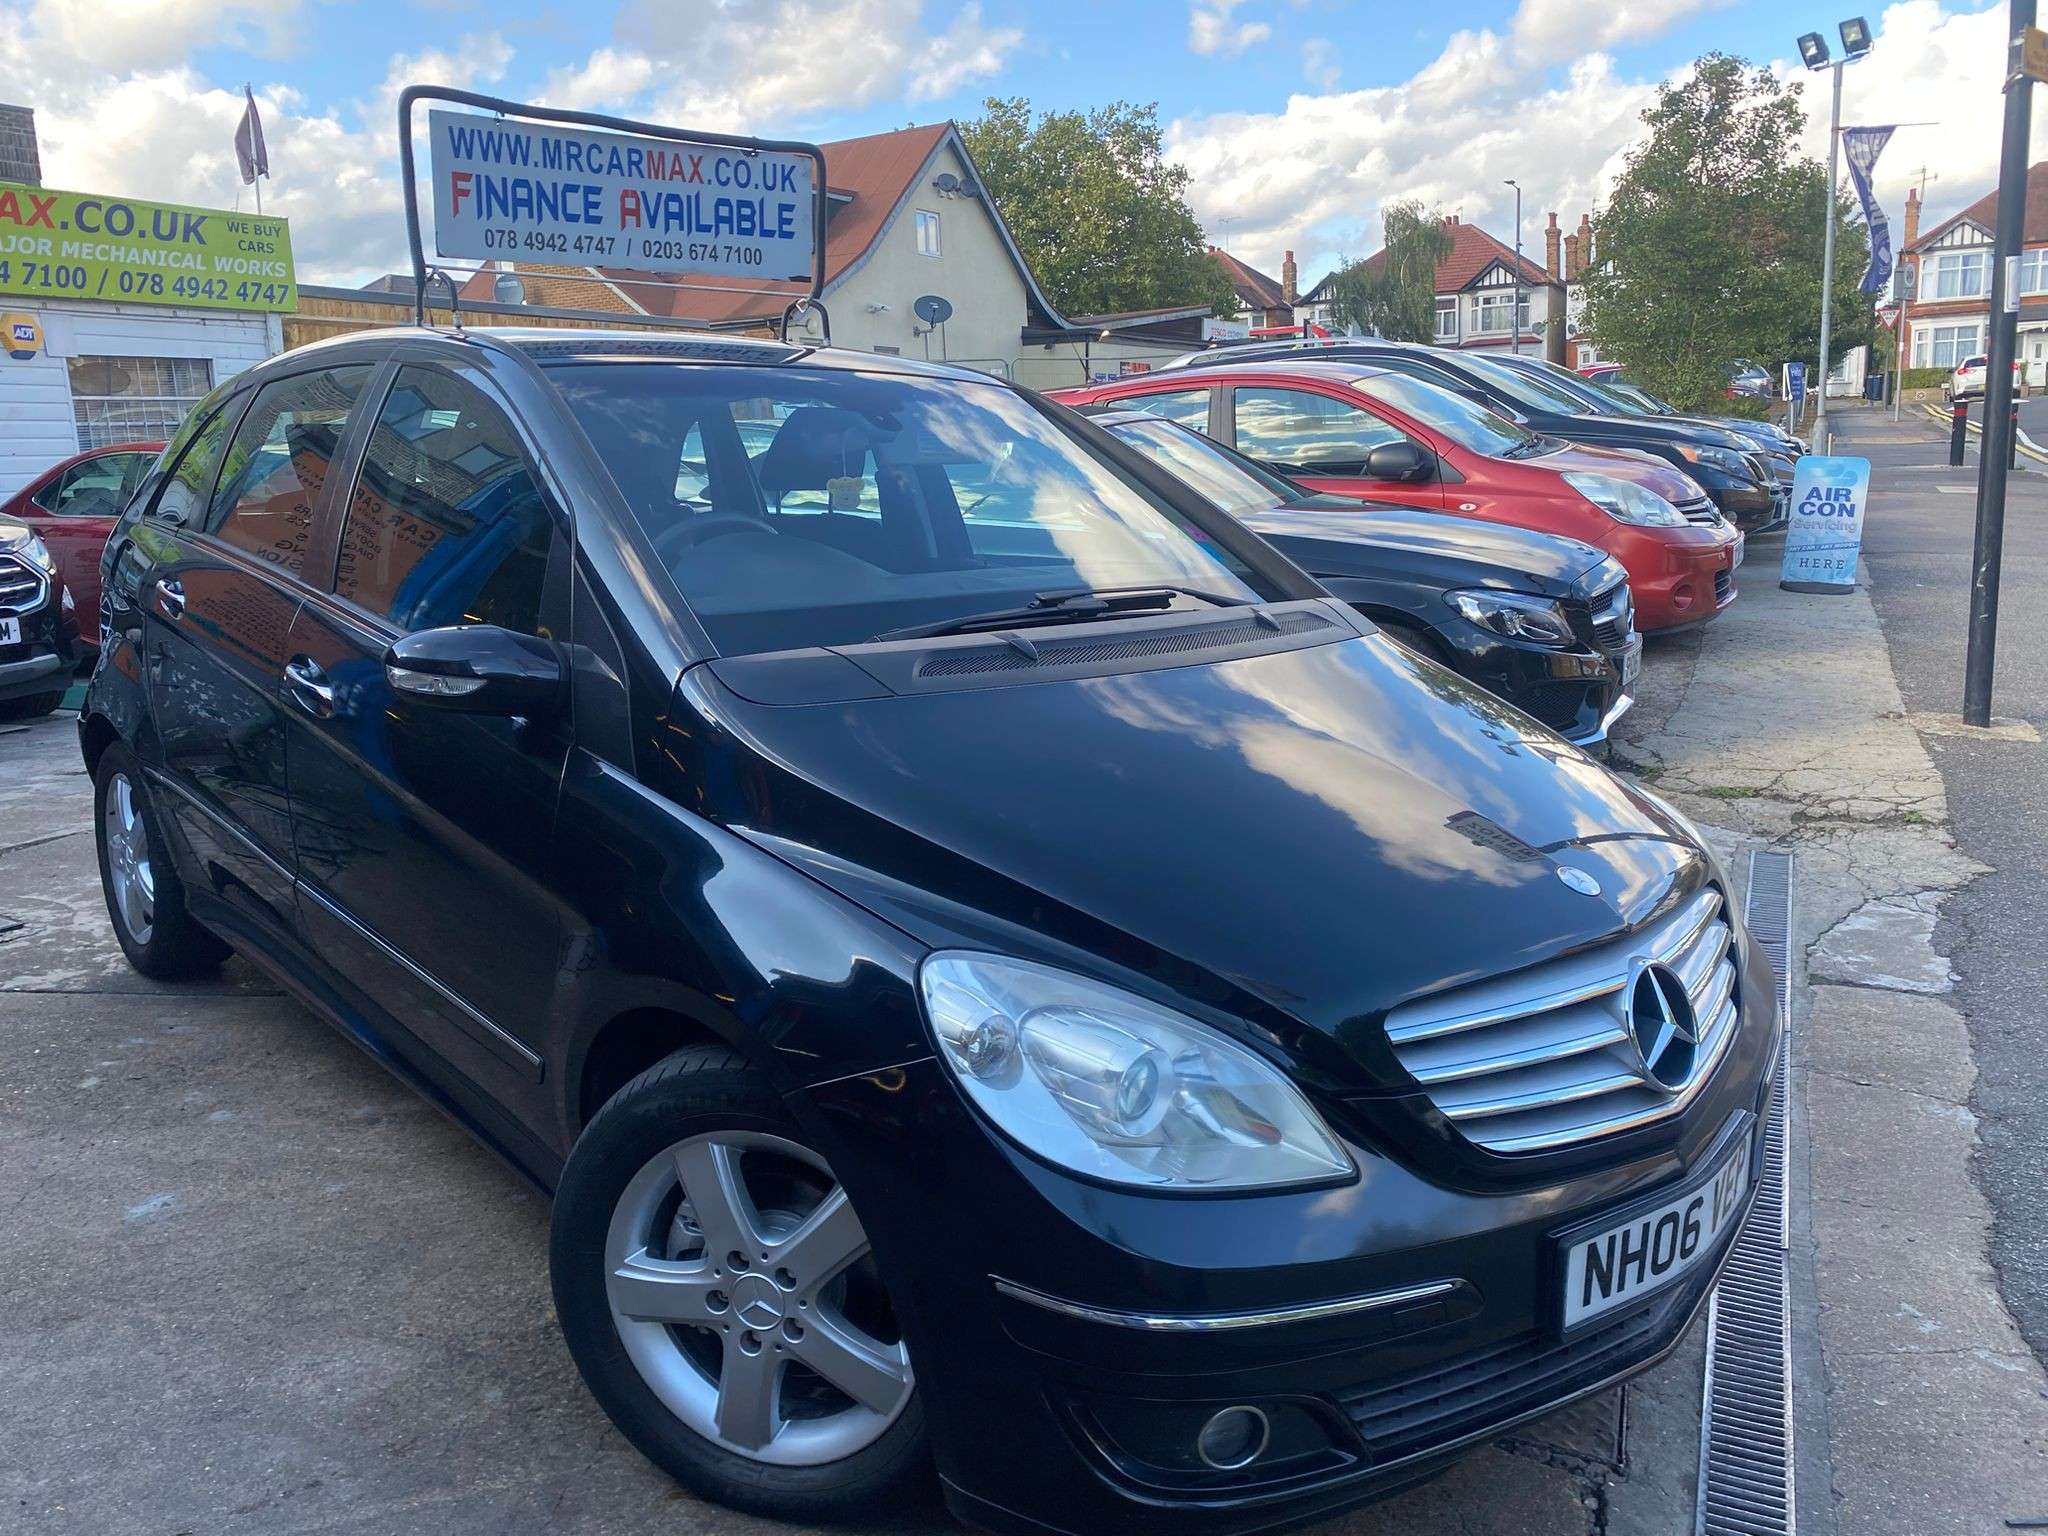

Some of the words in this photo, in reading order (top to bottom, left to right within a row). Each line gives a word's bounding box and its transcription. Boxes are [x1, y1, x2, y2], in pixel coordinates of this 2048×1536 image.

[447, 125, 797, 193] WWW.MRCARMAX.CO.UK
[450, 171, 604, 226] FINANCE
[619, 188, 796, 240] AVAILABLE
[226, 220, 249, 234] WE
[254, 223, 281, 238] BUY
[238, 239, 275, 254] CARS
[484, 229, 517, 249] 078
[524, 231, 568, 253] 4942
[573, 236, 616, 256] 4747
[642, 240, 683, 260] 0203
[689, 243, 719, 263] 674
[724, 246, 763, 266] 7100
[0, 235, 53, 257] JOR
[61, 240, 207, 271] MECHANICAL
[215, 255, 287, 278] WORKS
[22, 261, 88, 291] 7100
[119, 270, 165, 297] 078
[172, 275, 229, 301] 4942
[235, 281, 289, 305] 4747
[15, 327, 33, 339] ADT
[1805, 486, 1852, 502] AIR
[1798, 502, 1856, 517] CON
[1793, 519, 1857, 533] Servicing
[1800, 557, 1845, 569] HERE
[1582, 1196, 1705, 1308] NH06
